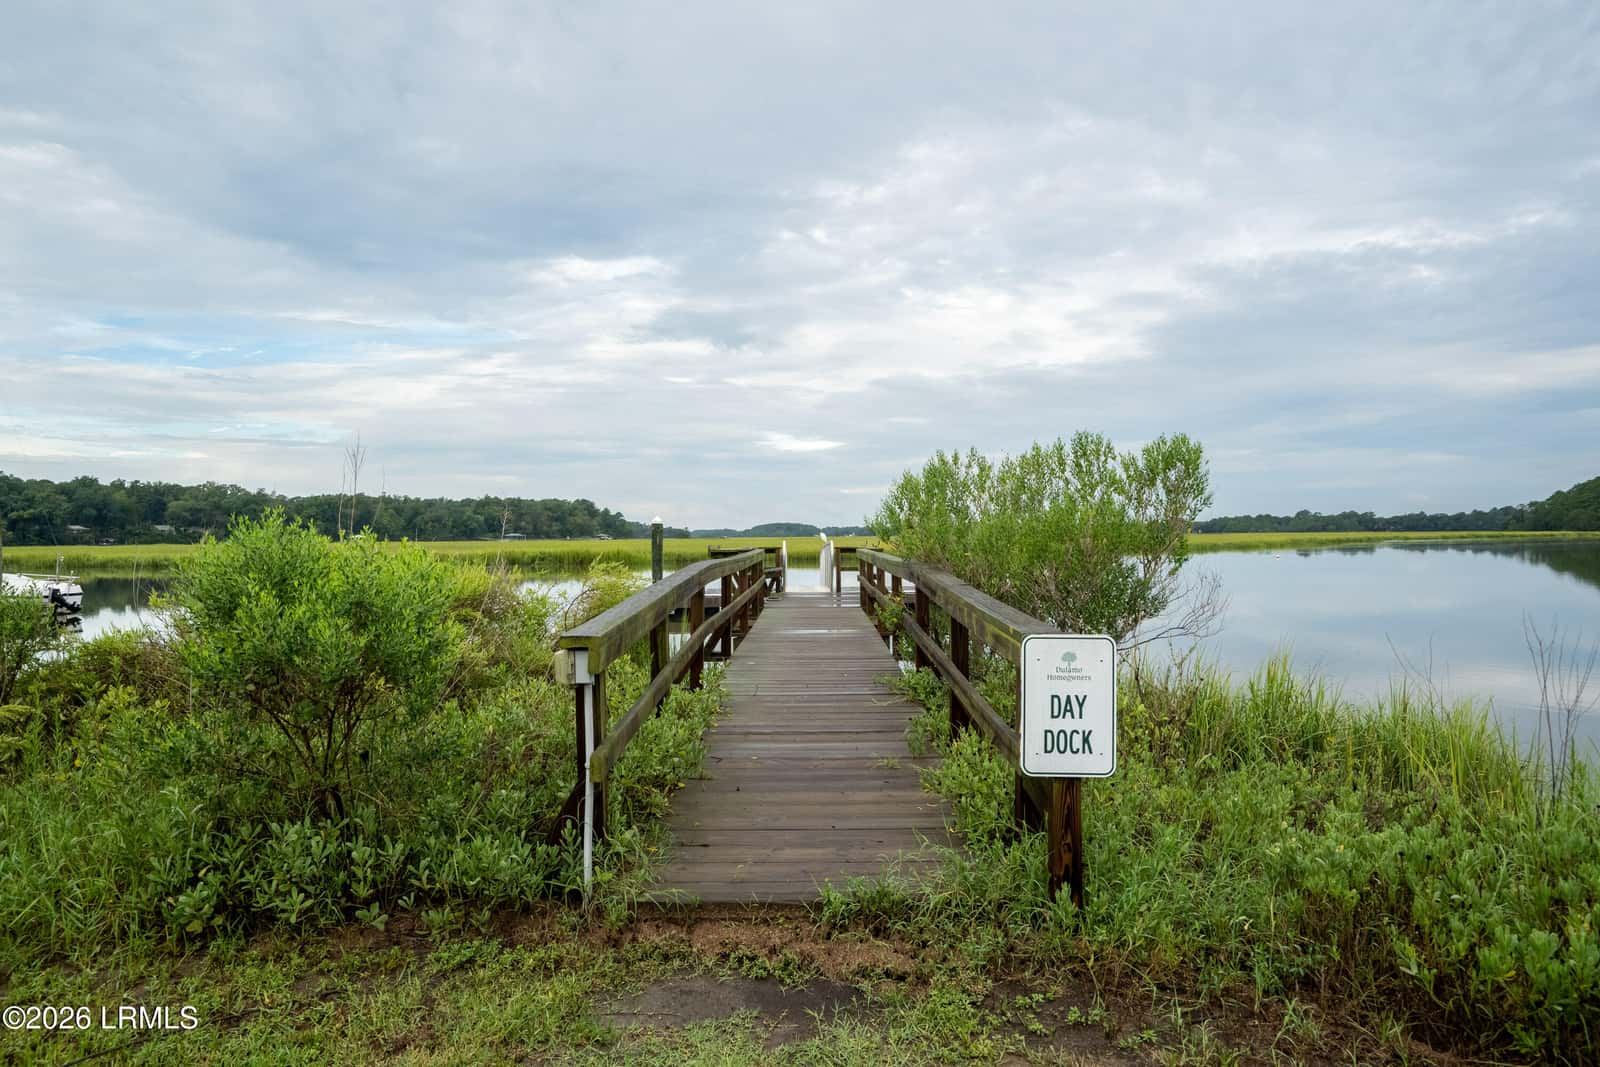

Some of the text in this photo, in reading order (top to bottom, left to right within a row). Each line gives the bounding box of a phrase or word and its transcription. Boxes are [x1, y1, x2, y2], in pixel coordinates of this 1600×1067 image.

[1047, 673, 1092, 682] Homeowners
[1050, 694, 1088, 720] DAY
[1043, 729, 1094, 756] DOCK
